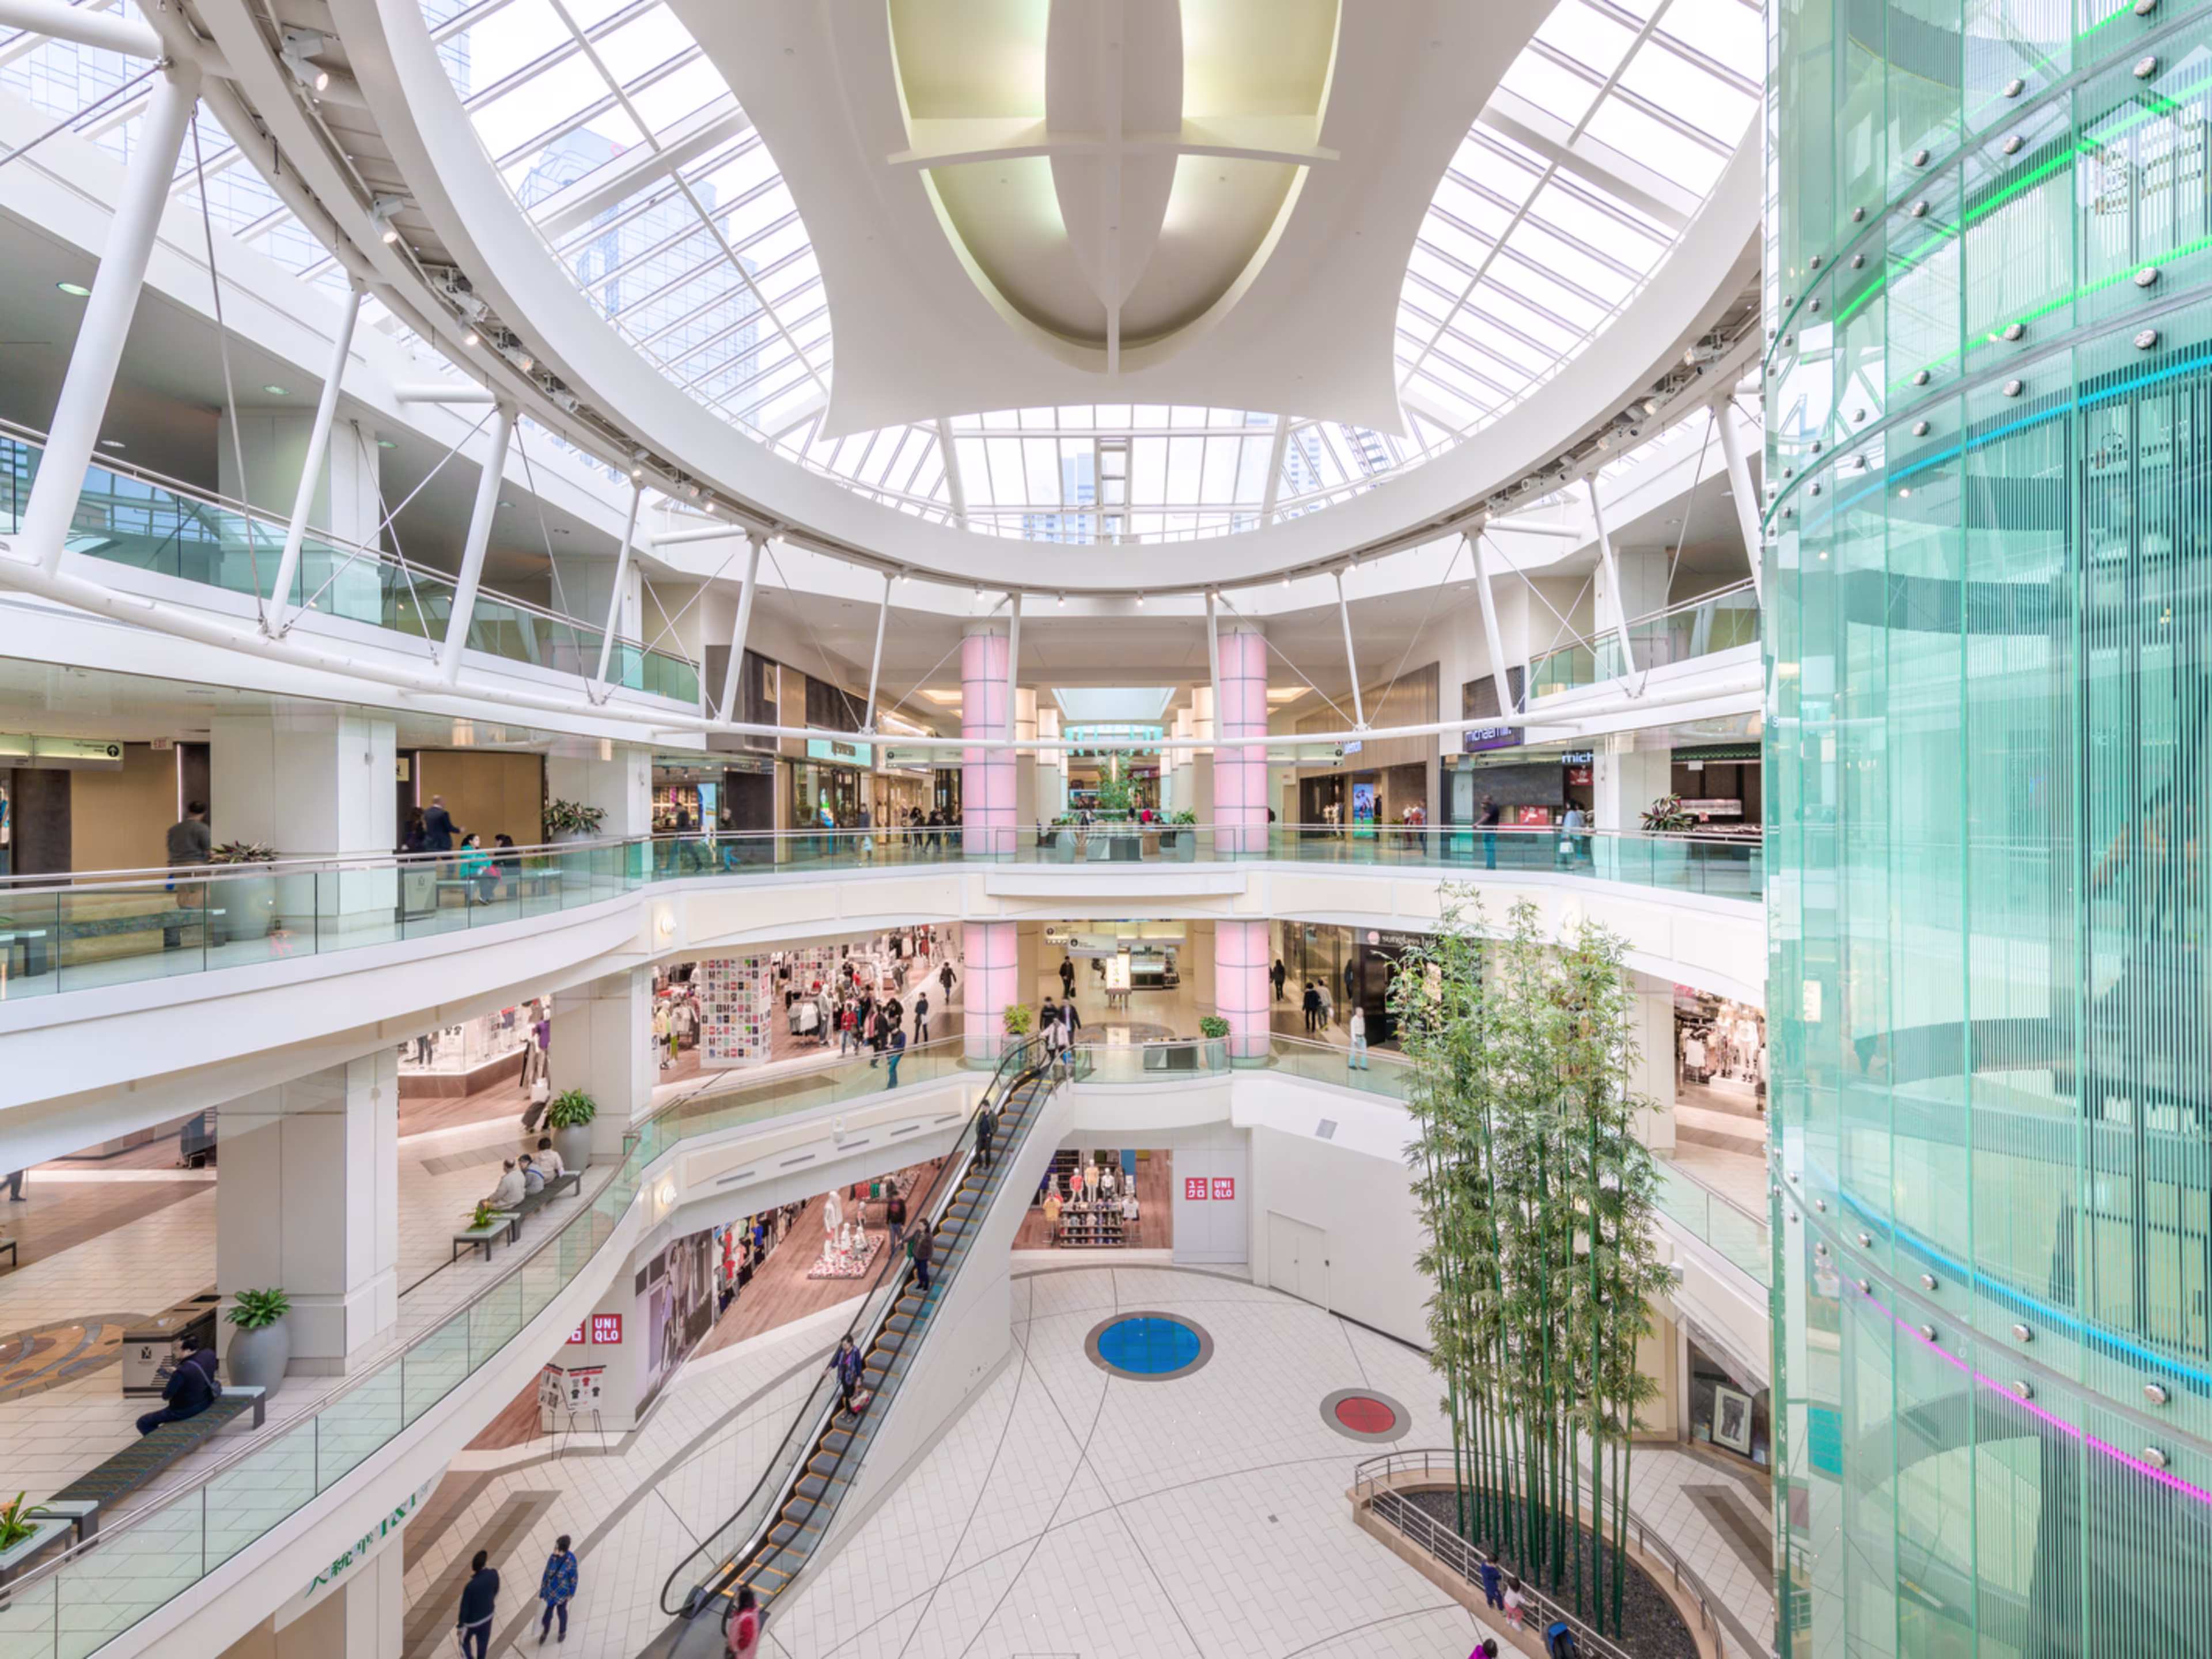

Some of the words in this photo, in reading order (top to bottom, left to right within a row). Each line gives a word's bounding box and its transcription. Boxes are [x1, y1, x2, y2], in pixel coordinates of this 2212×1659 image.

[1188, 1180, 1205, 1188] ユニ
[1214, 1180, 1230, 1188] UNI
[1214, 1190, 1232, 1199] QLO
[594, 1318, 617, 1329] UNI
[594, 1330, 619, 1342] QLO
